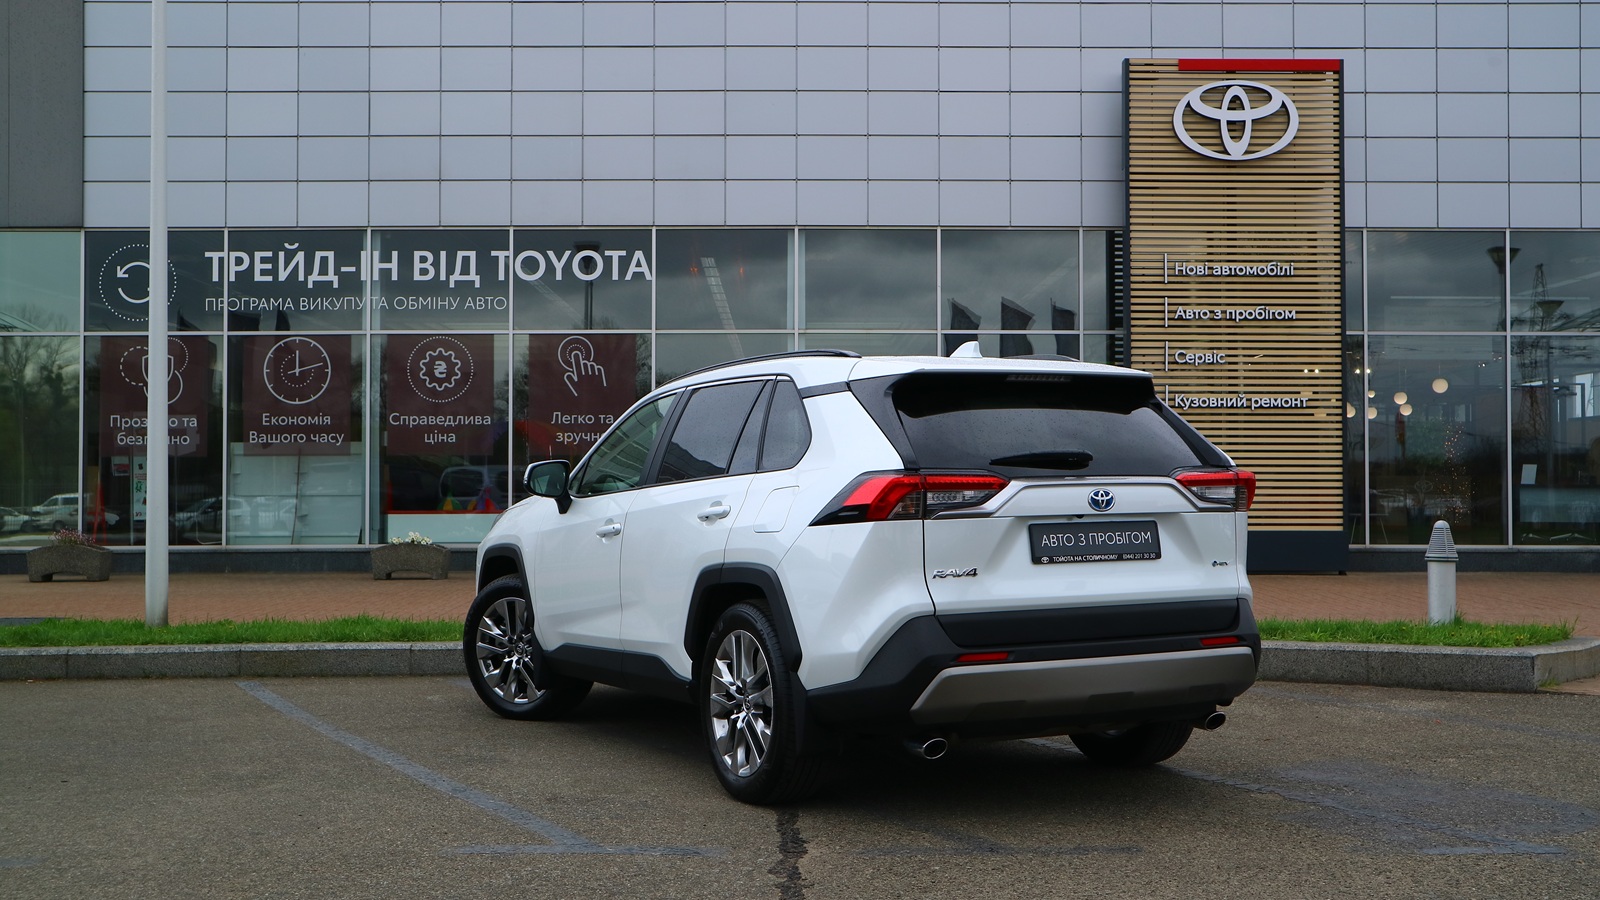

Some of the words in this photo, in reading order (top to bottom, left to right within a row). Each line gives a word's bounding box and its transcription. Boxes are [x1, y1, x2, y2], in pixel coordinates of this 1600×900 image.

[204, 242, 399, 289] ТРЕЙД-ІН
[413, 250, 481, 288] ВІД
[490, 249, 653, 281] TOYOTA
[1175, 262, 1208, 276] Нові
[1212, 262, 1294, 276] автомобілі
[300, 296, 367, 311] ВИКУПУ
[370, 296, 390, 310] ТА
[393, 296, 461, 310] ОБМІНУ
[463, 296, 508, 310] АВТО
[1174, 306, 1210, 320] Авто
[1213, 309, 1222, 320] з
[1226, 306, 1297, 323] пробігом
[1174, 350, 1226, 367] Сервіс
[1174, 394, 1247, 411] Кузовний
[1251, 397, 1309, 411] ремонт
[110, 415, 178, 430] Прозо
[182, 417, 198, 428] та
[262, 412, 332, 426] Економія
[389, 412, 492, 429] Справедлива
[551, 411, 595, 425] Легко
[598, 414, 614, 424] та
[249, 431, 307, 444] Вашого
[310, 433, 345, 446] часу
[424, 430, 456, 445] ціна
[555, 432, 605, 445] зручн
[1041, 533, 1075, 548] АВТО
[1078, 533, 1086, 546] З
[1088, 531, 1152, 546] ПРОБІГОМ
[931, 566, 979, 580] RAV4
